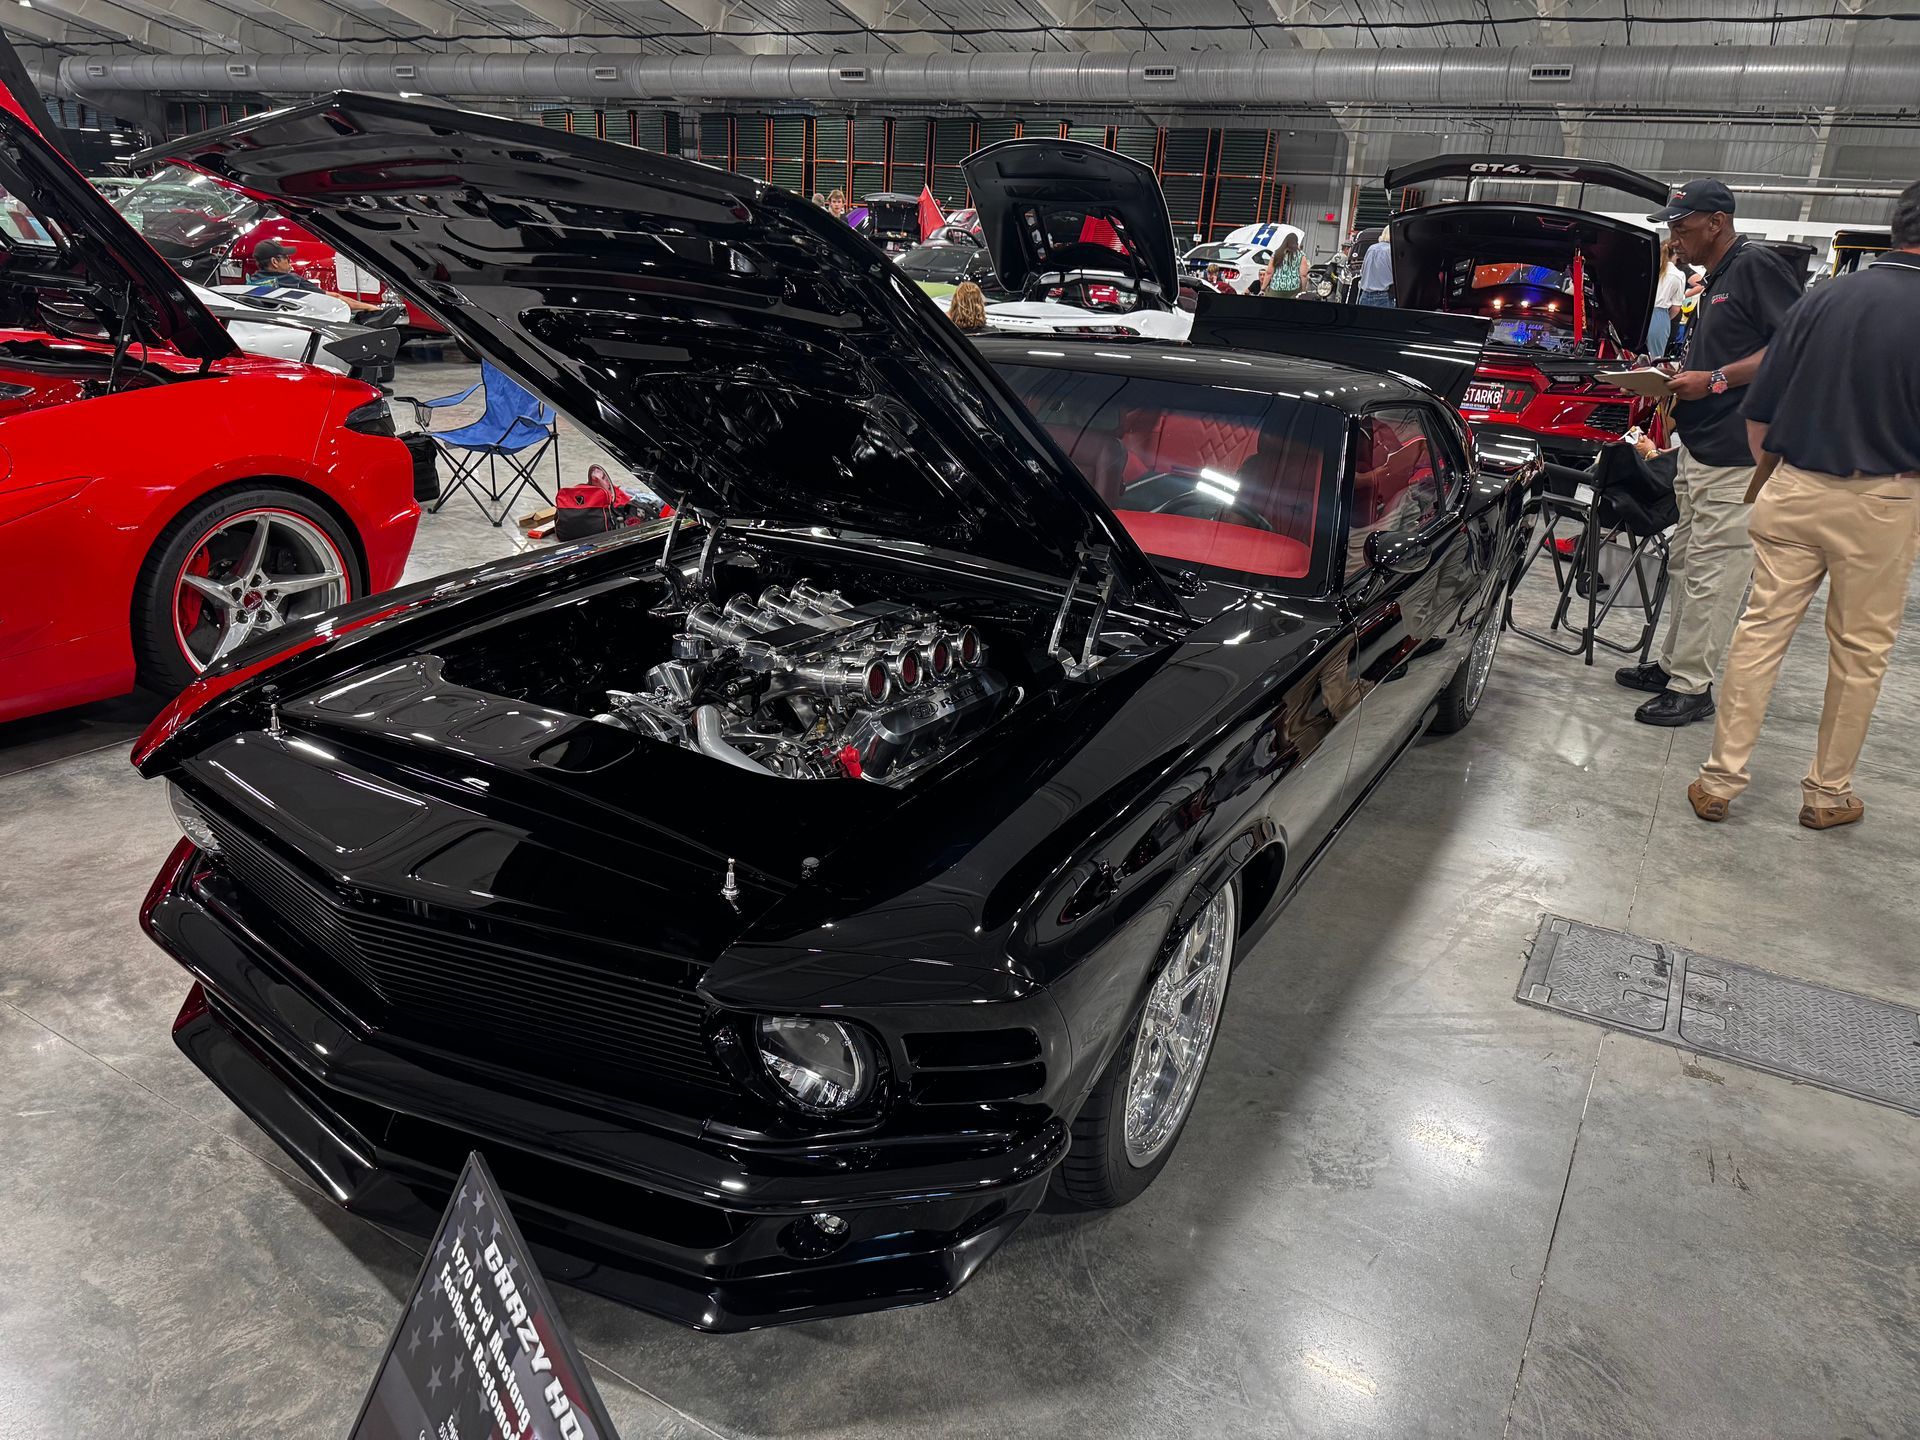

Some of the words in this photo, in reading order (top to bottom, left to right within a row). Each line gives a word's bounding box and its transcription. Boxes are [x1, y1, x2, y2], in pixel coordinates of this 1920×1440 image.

[1462, 387, 1501, 404] STARK8
[440, 1262, 476, 1350] Fastback
[450, 1238, 473, 1290] 1970
[470, 1283, 495, 1336] Ford
[489, 1328, 531, 1429] Mustang
[483, 1239, 552, 1375] CRAZY
